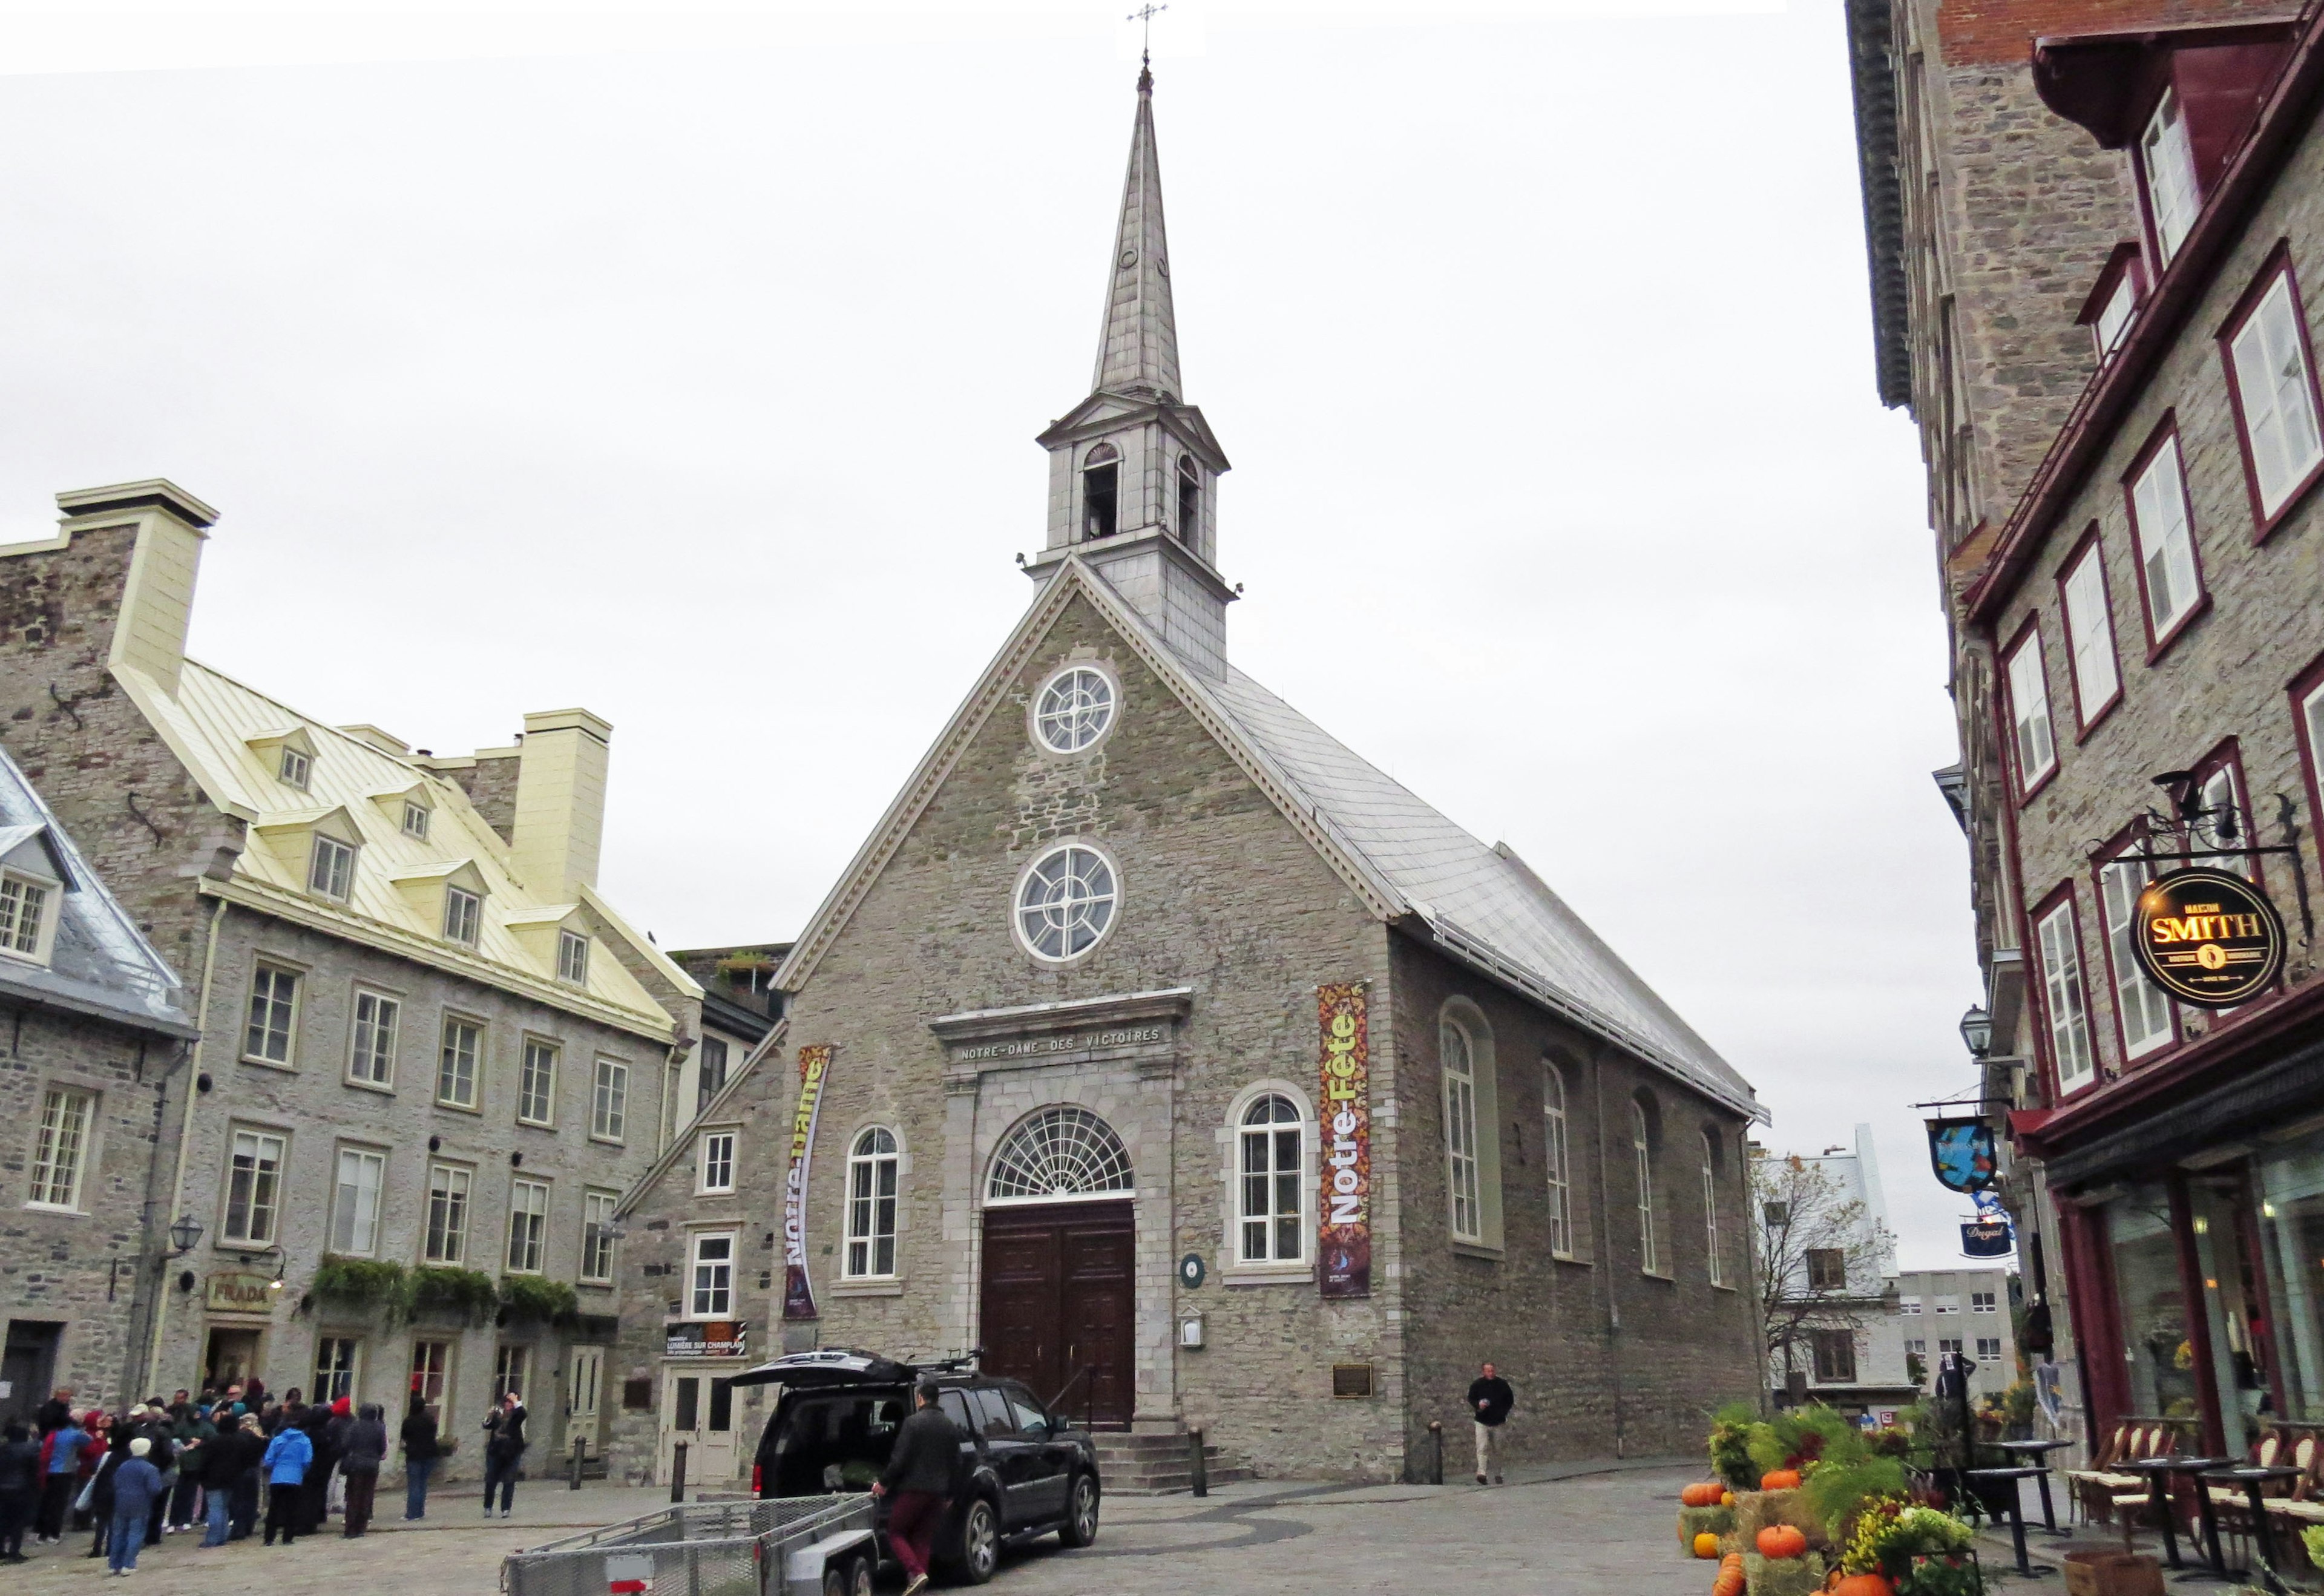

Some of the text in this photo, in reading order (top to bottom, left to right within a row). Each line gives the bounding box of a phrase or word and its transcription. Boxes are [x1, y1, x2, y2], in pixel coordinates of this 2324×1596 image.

[2184, 903, 2220, 914] MAISON
[2150, 913, 2262, 942] SMITH
[961, 1029, 1159, 1060] NOTRE-DAME DES VICTOIRES
[1325, 1014, 1359, 1224] Notre-Fête
[667, 1341, 692, 1349] LUMIÈRE
[707, 1340, 745, 1349] CHAMPLAIN
